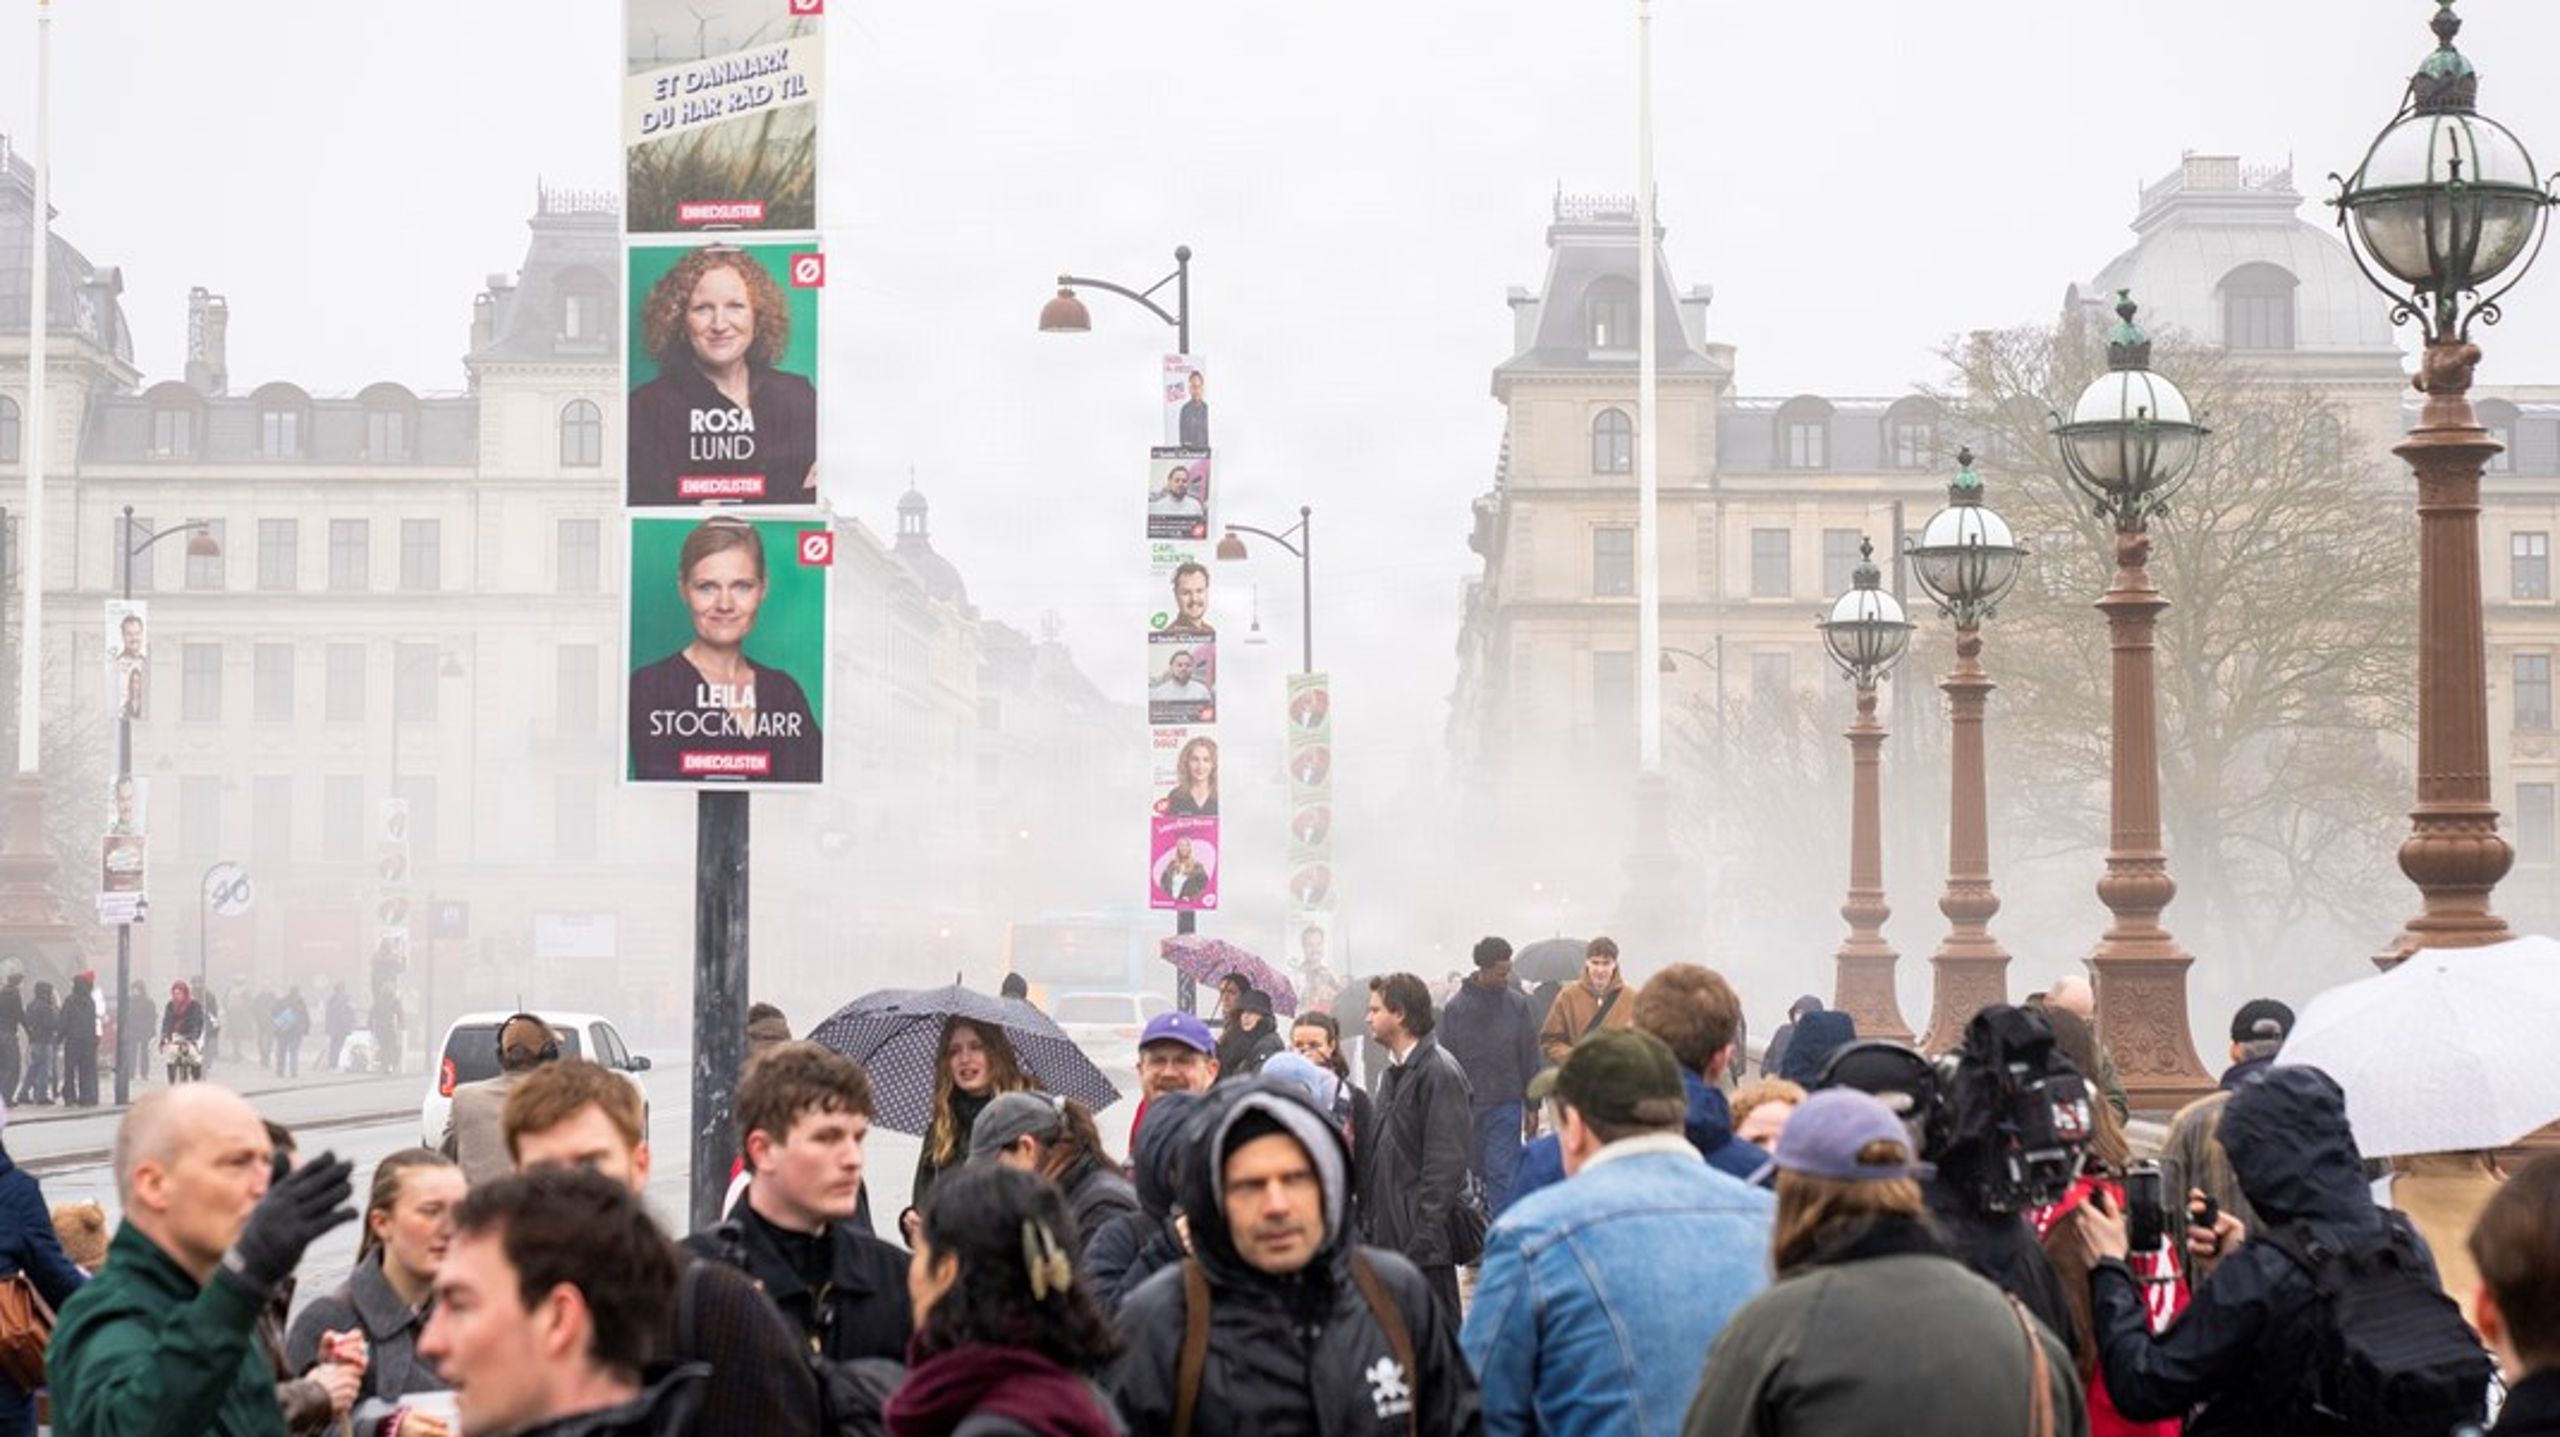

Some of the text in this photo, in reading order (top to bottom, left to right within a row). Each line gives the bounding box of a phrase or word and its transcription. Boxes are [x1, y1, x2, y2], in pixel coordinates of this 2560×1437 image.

[655, 48, 788, 100] ET DANMARK
[641, 73, 808, 135] DU HAR RÅD TIL
[690, 408, 755, 433] ROSA
[690, 435, 755, 460] LUND
[697, 683, 757, 709] LEILA
[650, 710, 802, 737] STOCKMARR
